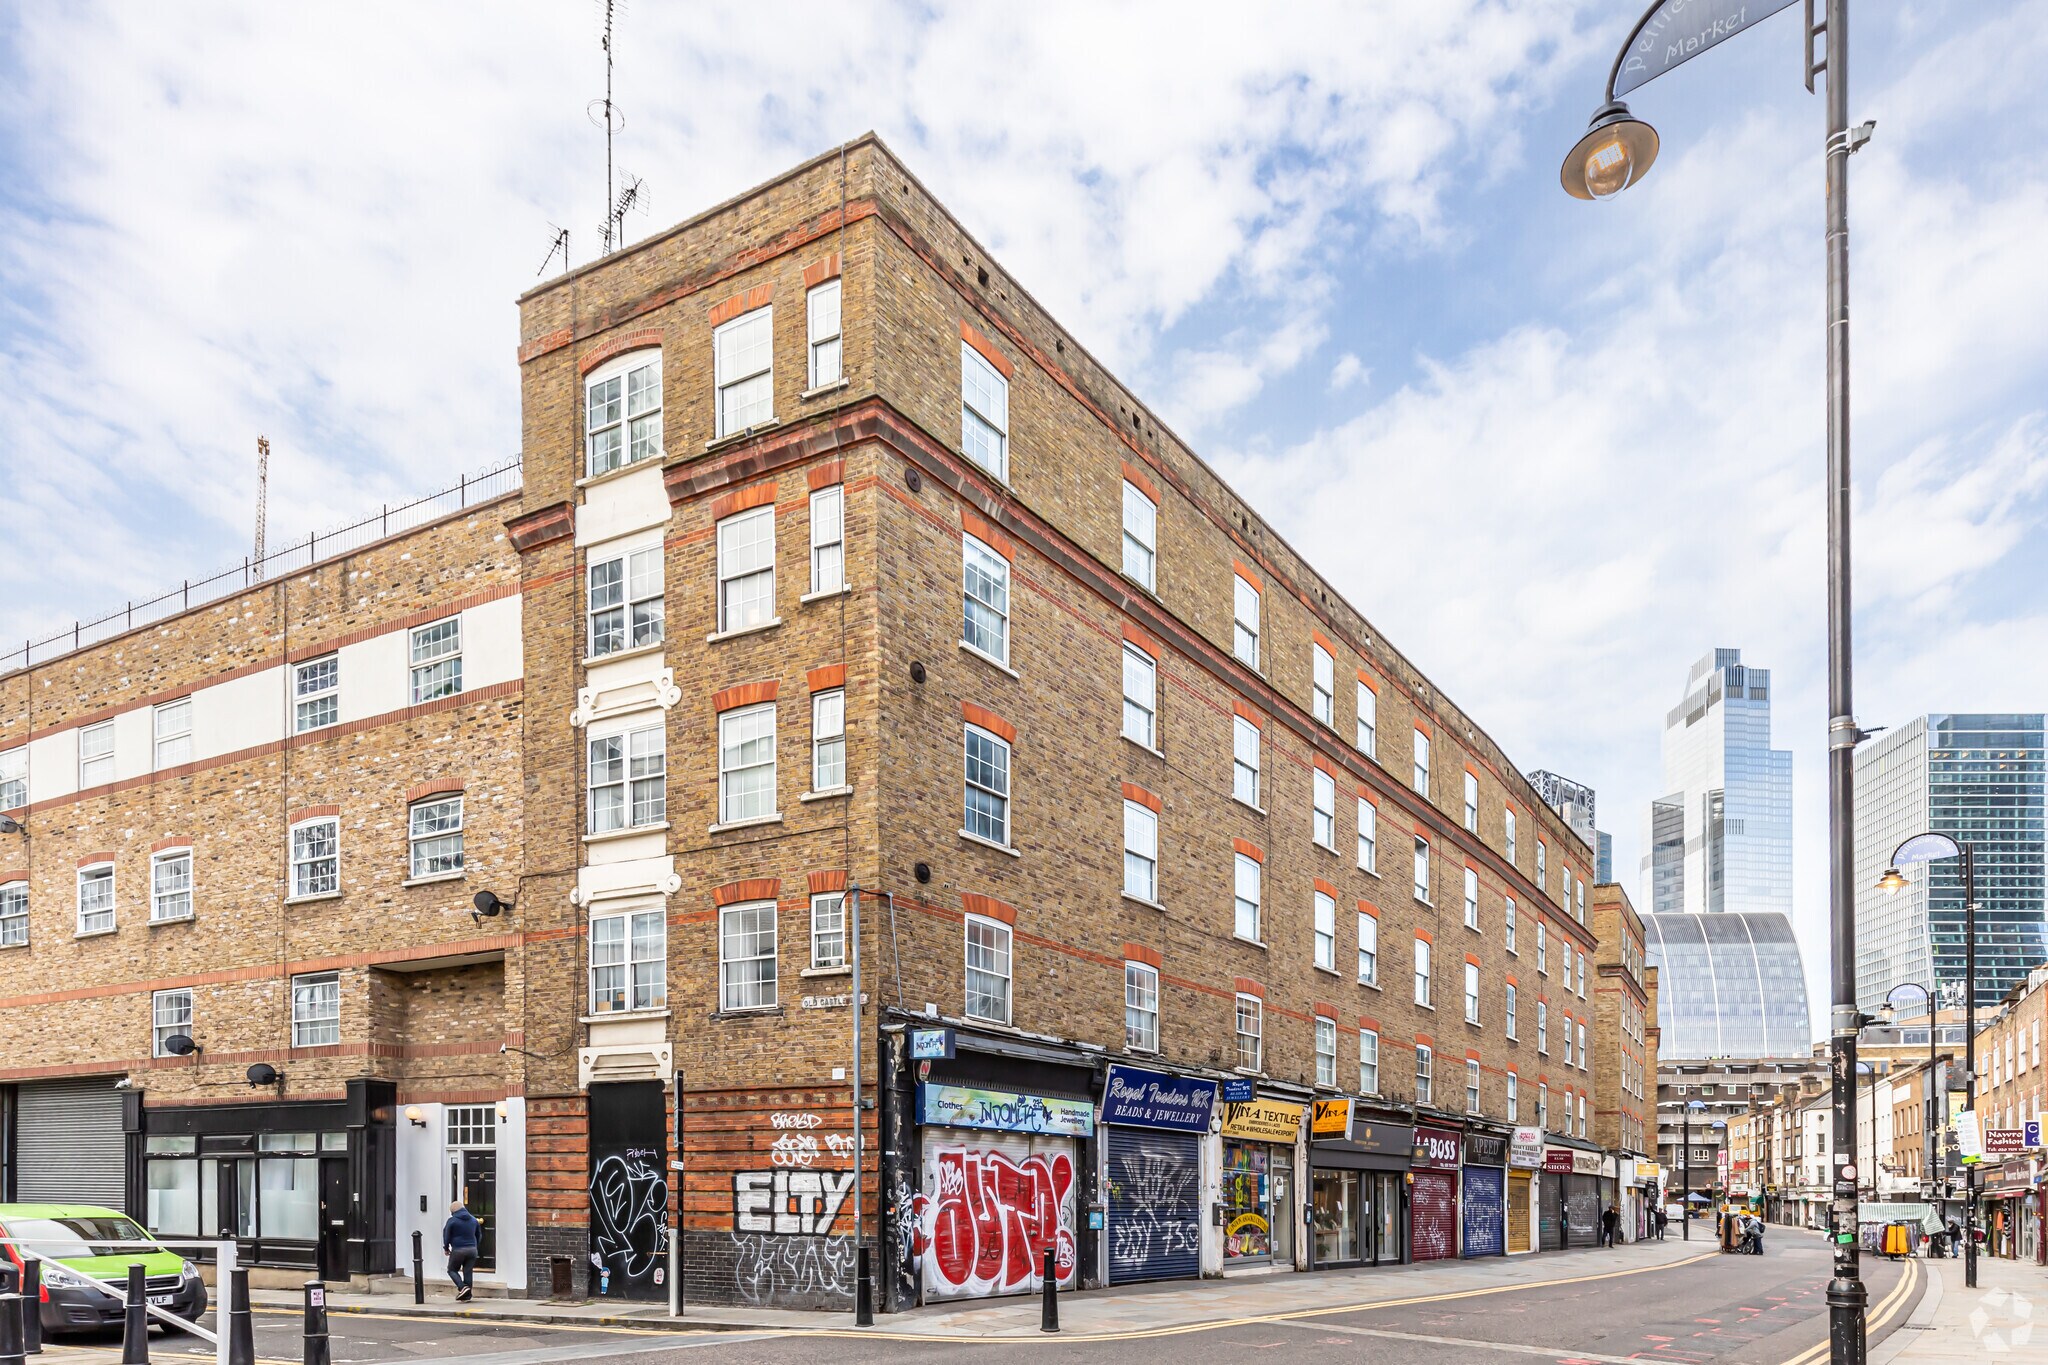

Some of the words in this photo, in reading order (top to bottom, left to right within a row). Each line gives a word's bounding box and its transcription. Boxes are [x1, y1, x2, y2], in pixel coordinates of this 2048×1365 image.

[1624, 0, 1694, 74] Pettic
[1664, 6, 1747, 64] Market
[1109, 1077, 1147, 1104] Royal
[1149, 1083, 1189, 1107] Traders
[1191, 1089, 1212, 1109] UK
[937, 1100, 963, 1110] Clothes
[1060, 1107, 1090, 1118] Handmade
[1114, 1105, 1143, 1118] BEADS
[1144, 1108, 1152, 1119] &
[1152, 1109, 1202, 1124] JEWELLERY
[1264, 1110, 1301, 1125] TEXTILES
[1060, 1115, 1086, 1128] Jewellery
[1229, 1123, 1246, 1131] RETAIL
[1249, 1126, 1277, 1135] WHOLESALE
[1987, 1137, 2023, 1145] Fashion
[151, 1296, 167, 1304] VLF
